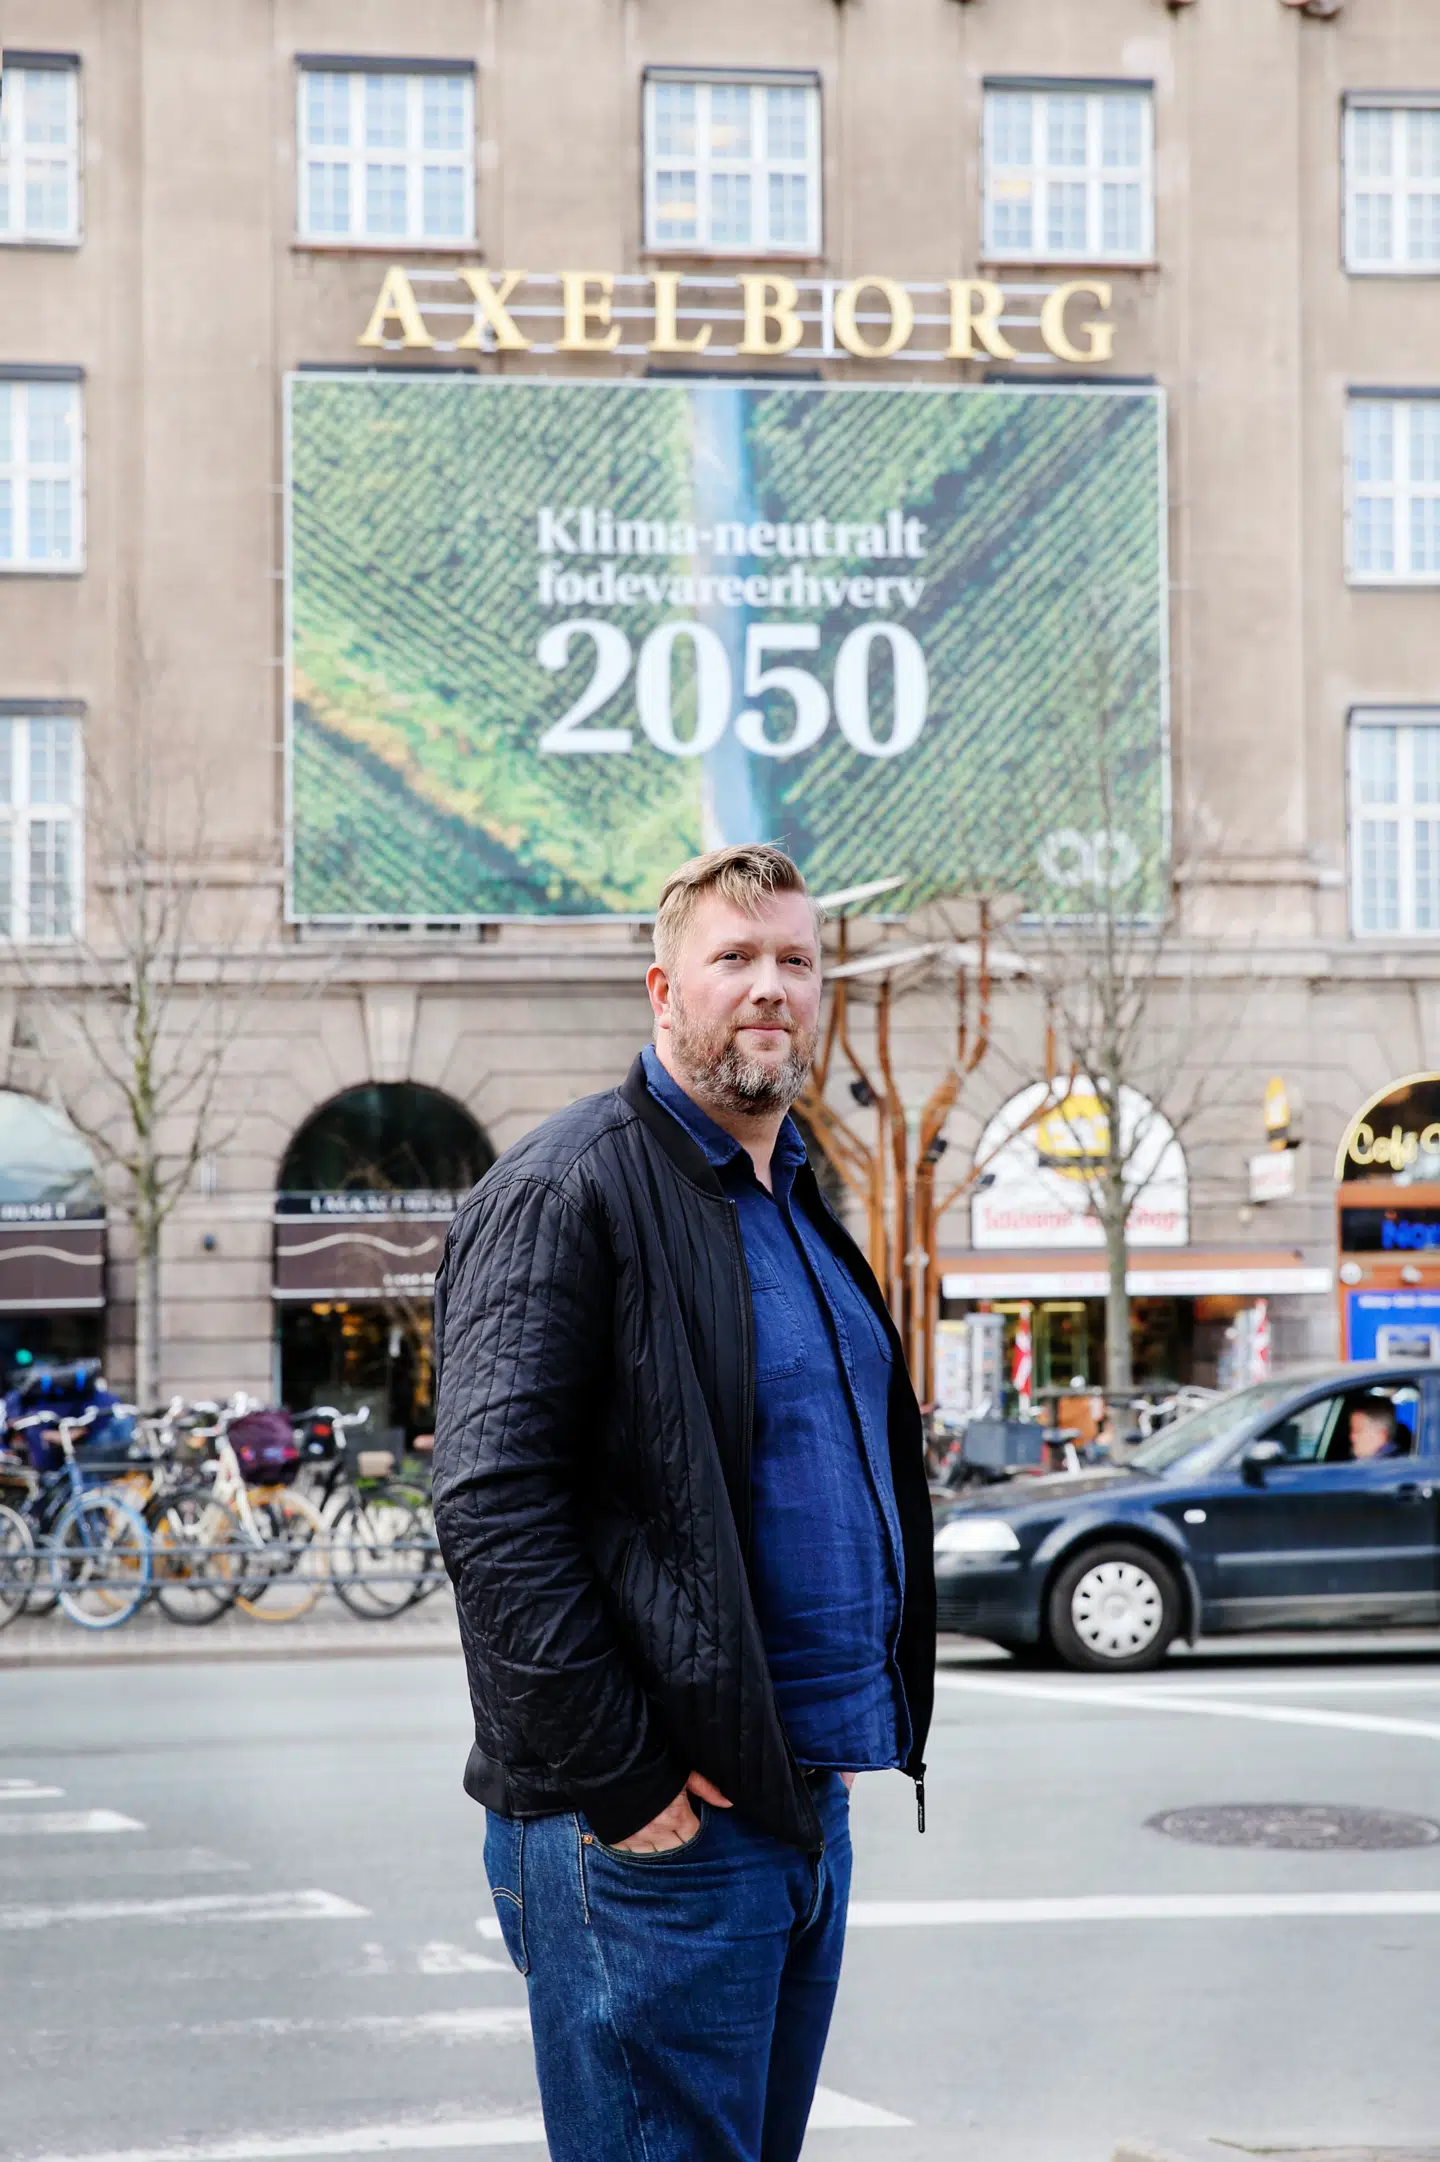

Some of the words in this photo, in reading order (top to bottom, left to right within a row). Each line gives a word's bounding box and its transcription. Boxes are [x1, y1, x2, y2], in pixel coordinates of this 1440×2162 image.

[356, 265, 1118, 364] AXELBORG
[536, 506, 928, 558] Klima-neutralt
[536, 618, 930, 758] 2050
